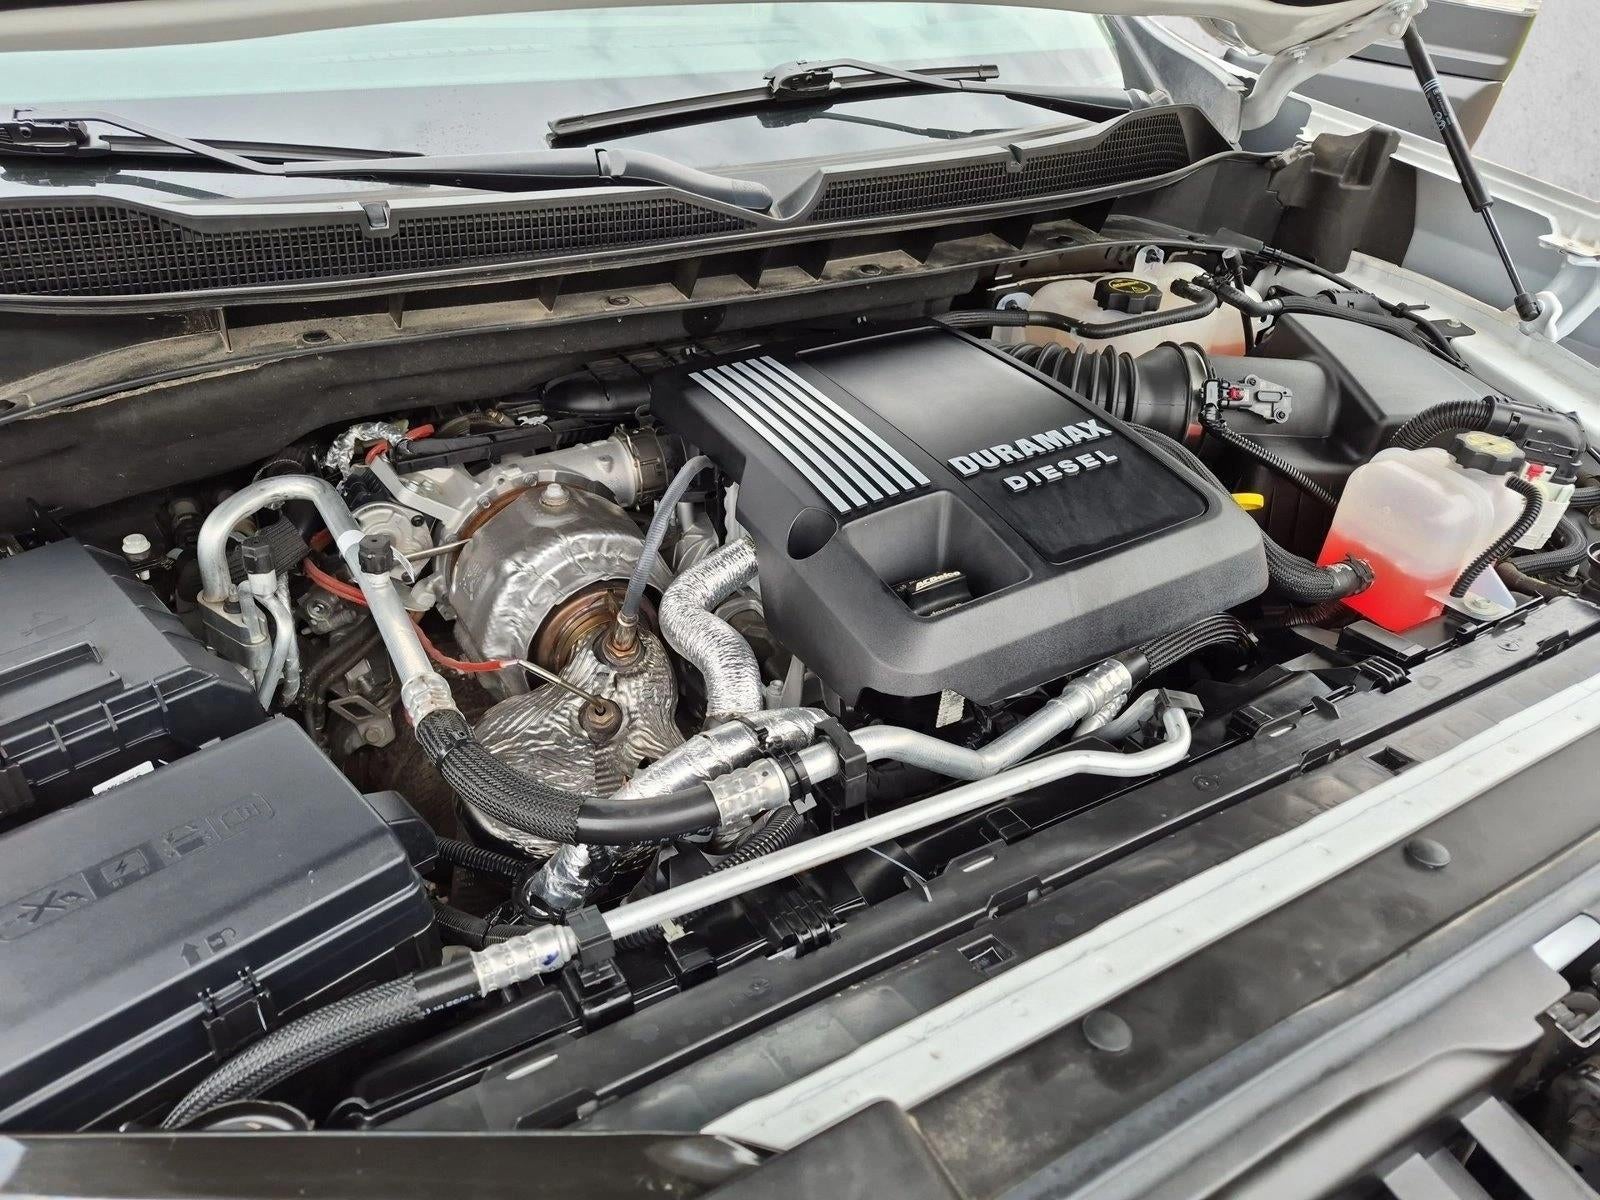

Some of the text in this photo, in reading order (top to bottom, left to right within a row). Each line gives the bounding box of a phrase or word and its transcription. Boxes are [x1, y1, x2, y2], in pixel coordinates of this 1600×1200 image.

[948, 419, 1112, 477] DURAMAX
[1003, 450, 1118, 492] DIESEL
[915, 571, 961, 591] ACDelco
